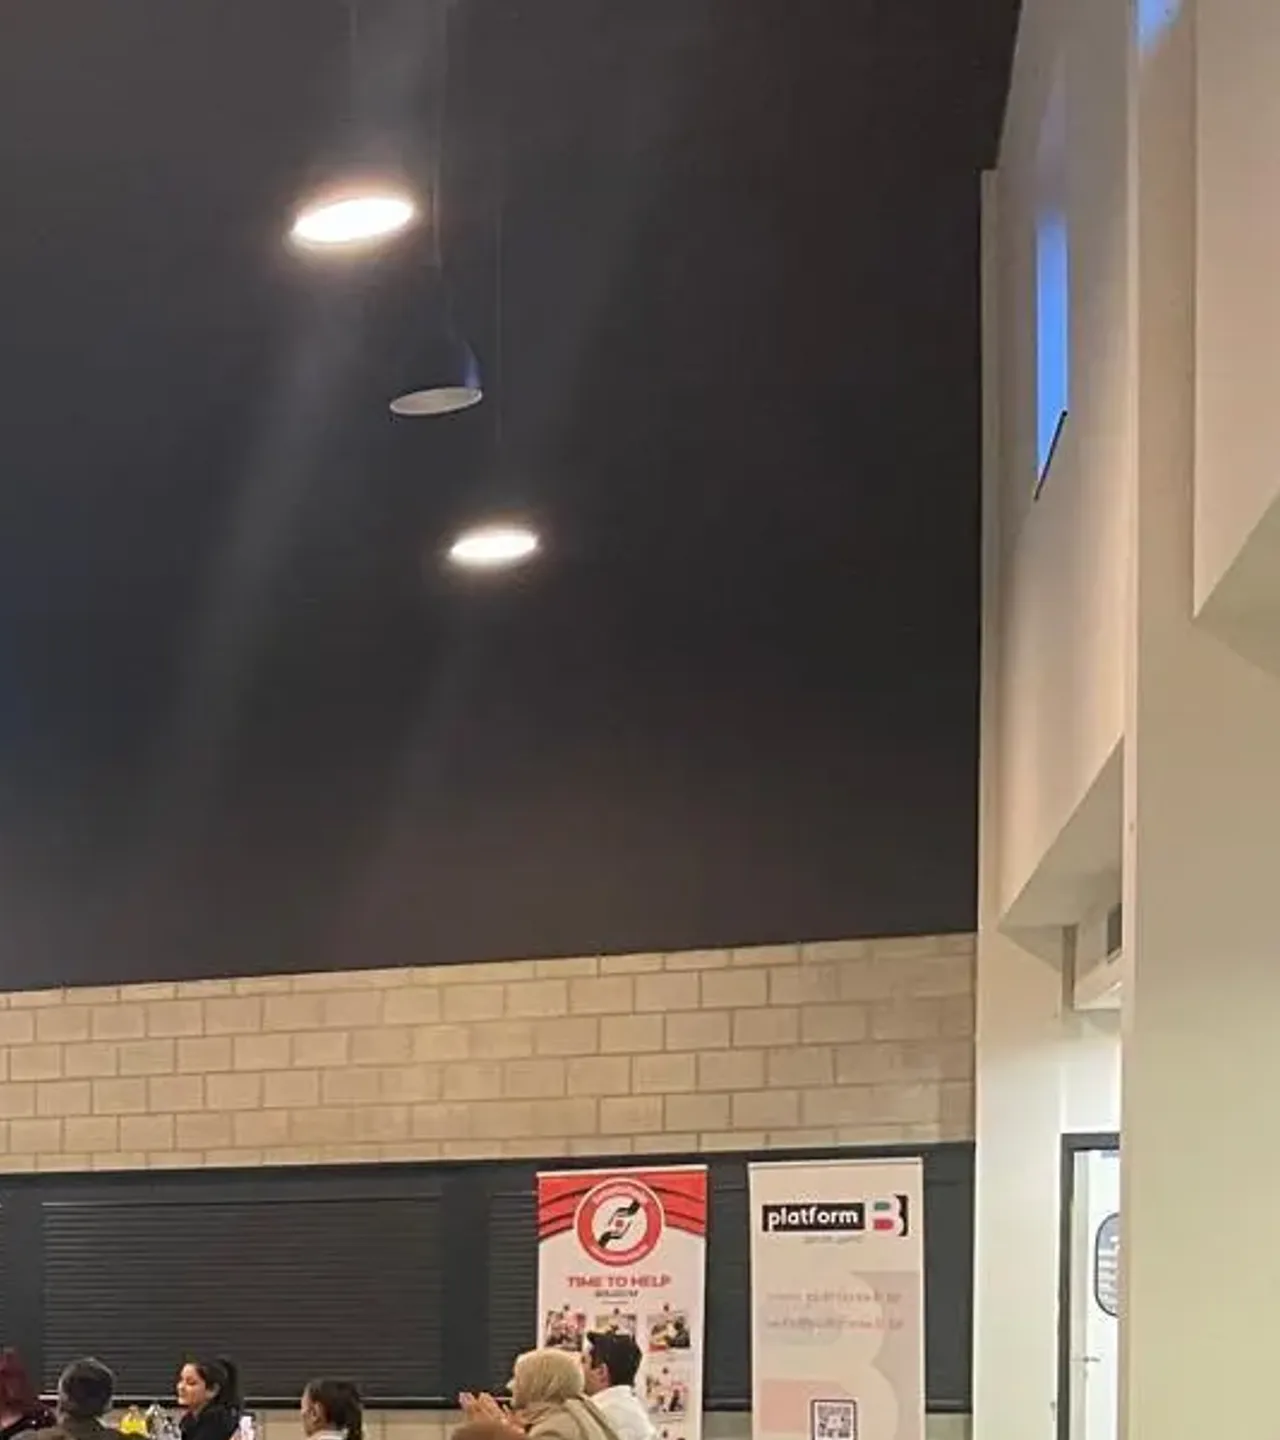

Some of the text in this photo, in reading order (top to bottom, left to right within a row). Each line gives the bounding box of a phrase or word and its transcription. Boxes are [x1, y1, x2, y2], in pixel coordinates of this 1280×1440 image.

[768, 1206, 858, 1231] platform
[568, 1274, 671, 1288] TIME TO HELP
